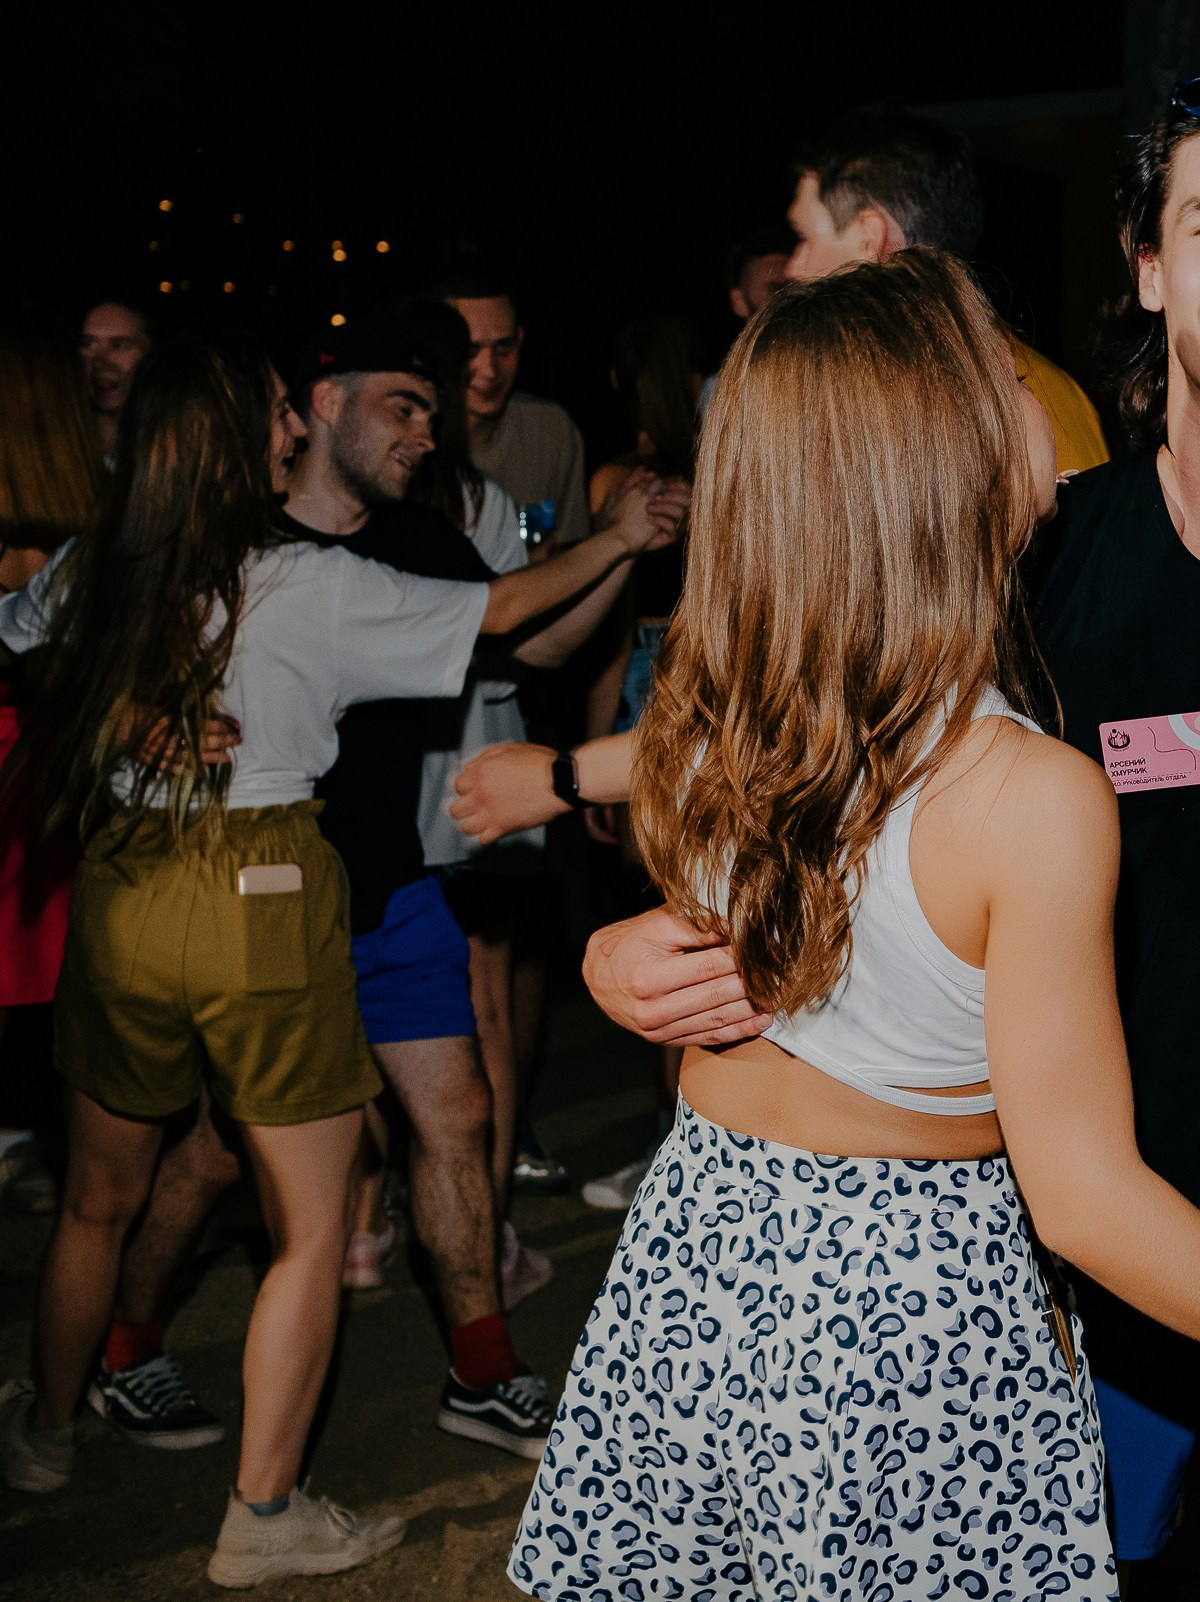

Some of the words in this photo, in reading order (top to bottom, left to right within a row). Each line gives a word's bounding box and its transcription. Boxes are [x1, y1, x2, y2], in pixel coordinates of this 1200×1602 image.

[1109, 757, 1147, 769] АРСЕНИЙ
[1111, 766, 1148, 778] ХМУРЧИК
[1122, 776, 1165, 787] РУКОВОДИТЕЛЬ
